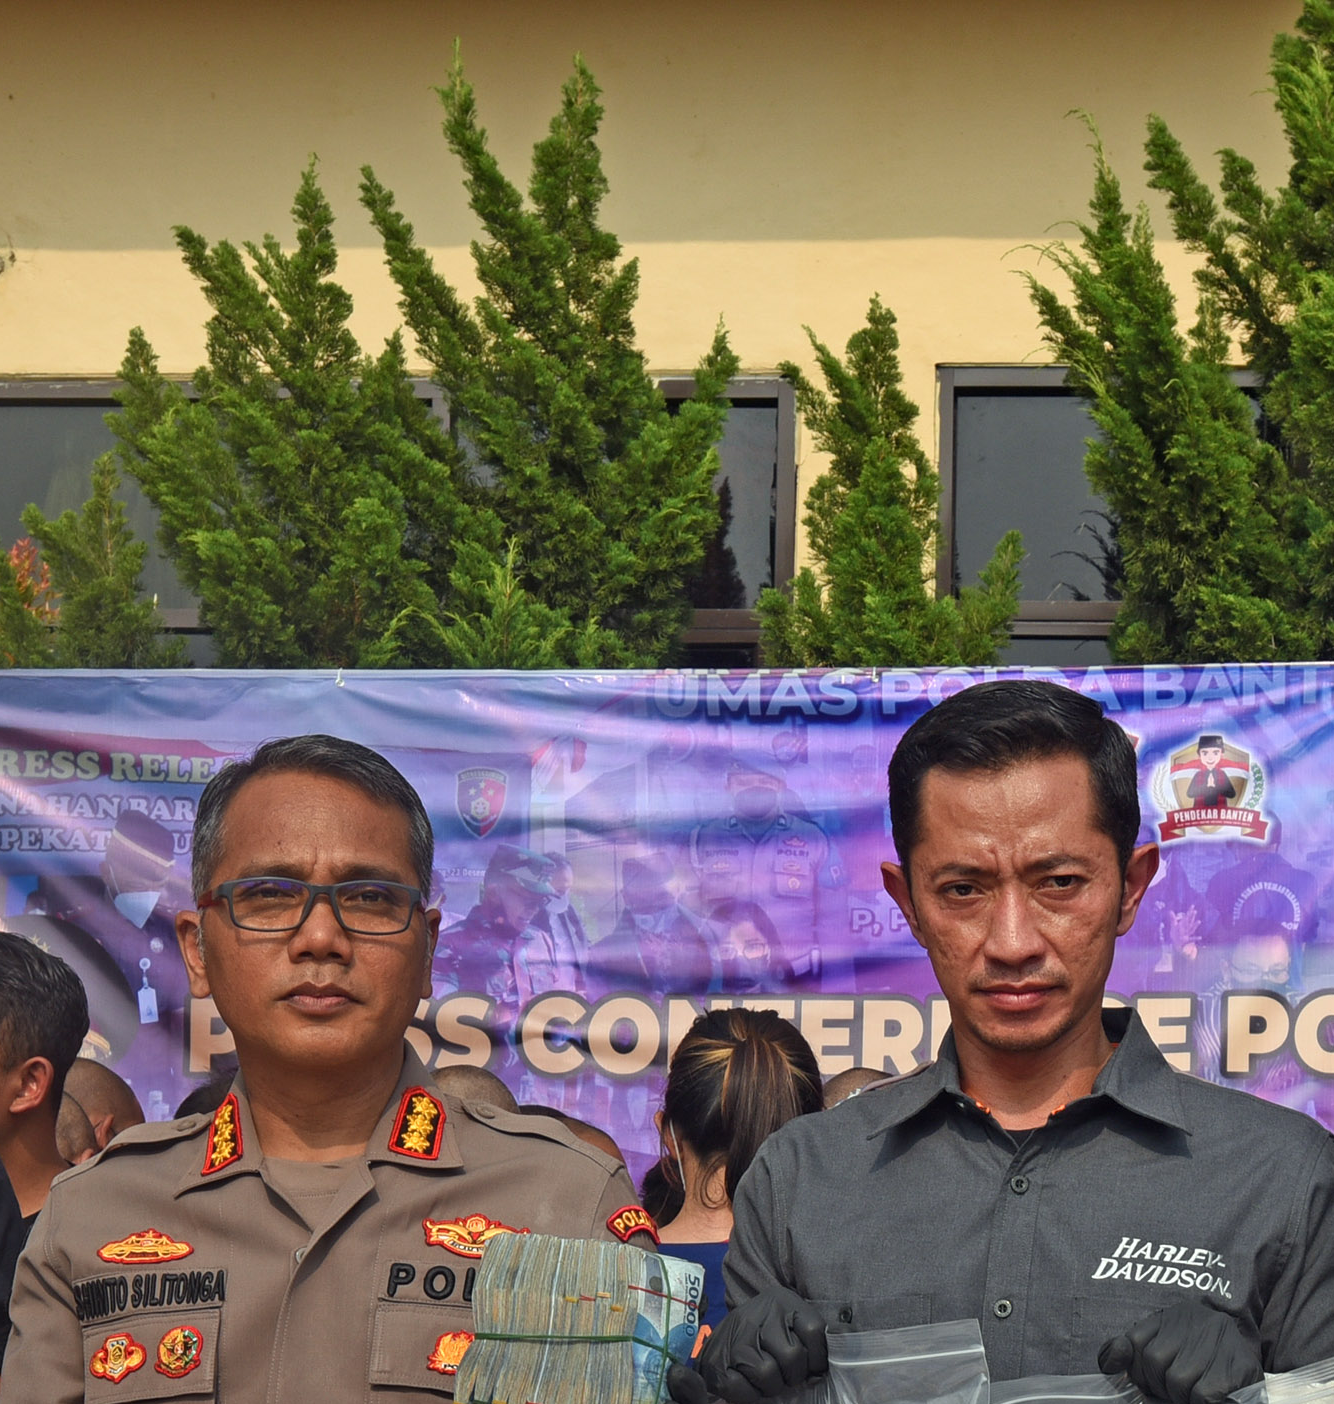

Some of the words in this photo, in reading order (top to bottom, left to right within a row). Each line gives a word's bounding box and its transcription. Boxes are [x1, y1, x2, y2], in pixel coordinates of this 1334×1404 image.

[654, 668, 858, 717] UMAS
[109, 751, 233, 784] RELE
[128, 796, 197, 821] BAR
[1173, 808, 1219, 824] PENDEKAR
[1220, 809, 1255, 823] BANTEN
[130, 1268, 226, 1309] SILITONGA
[682, 1271, 702, 1338] 50000
